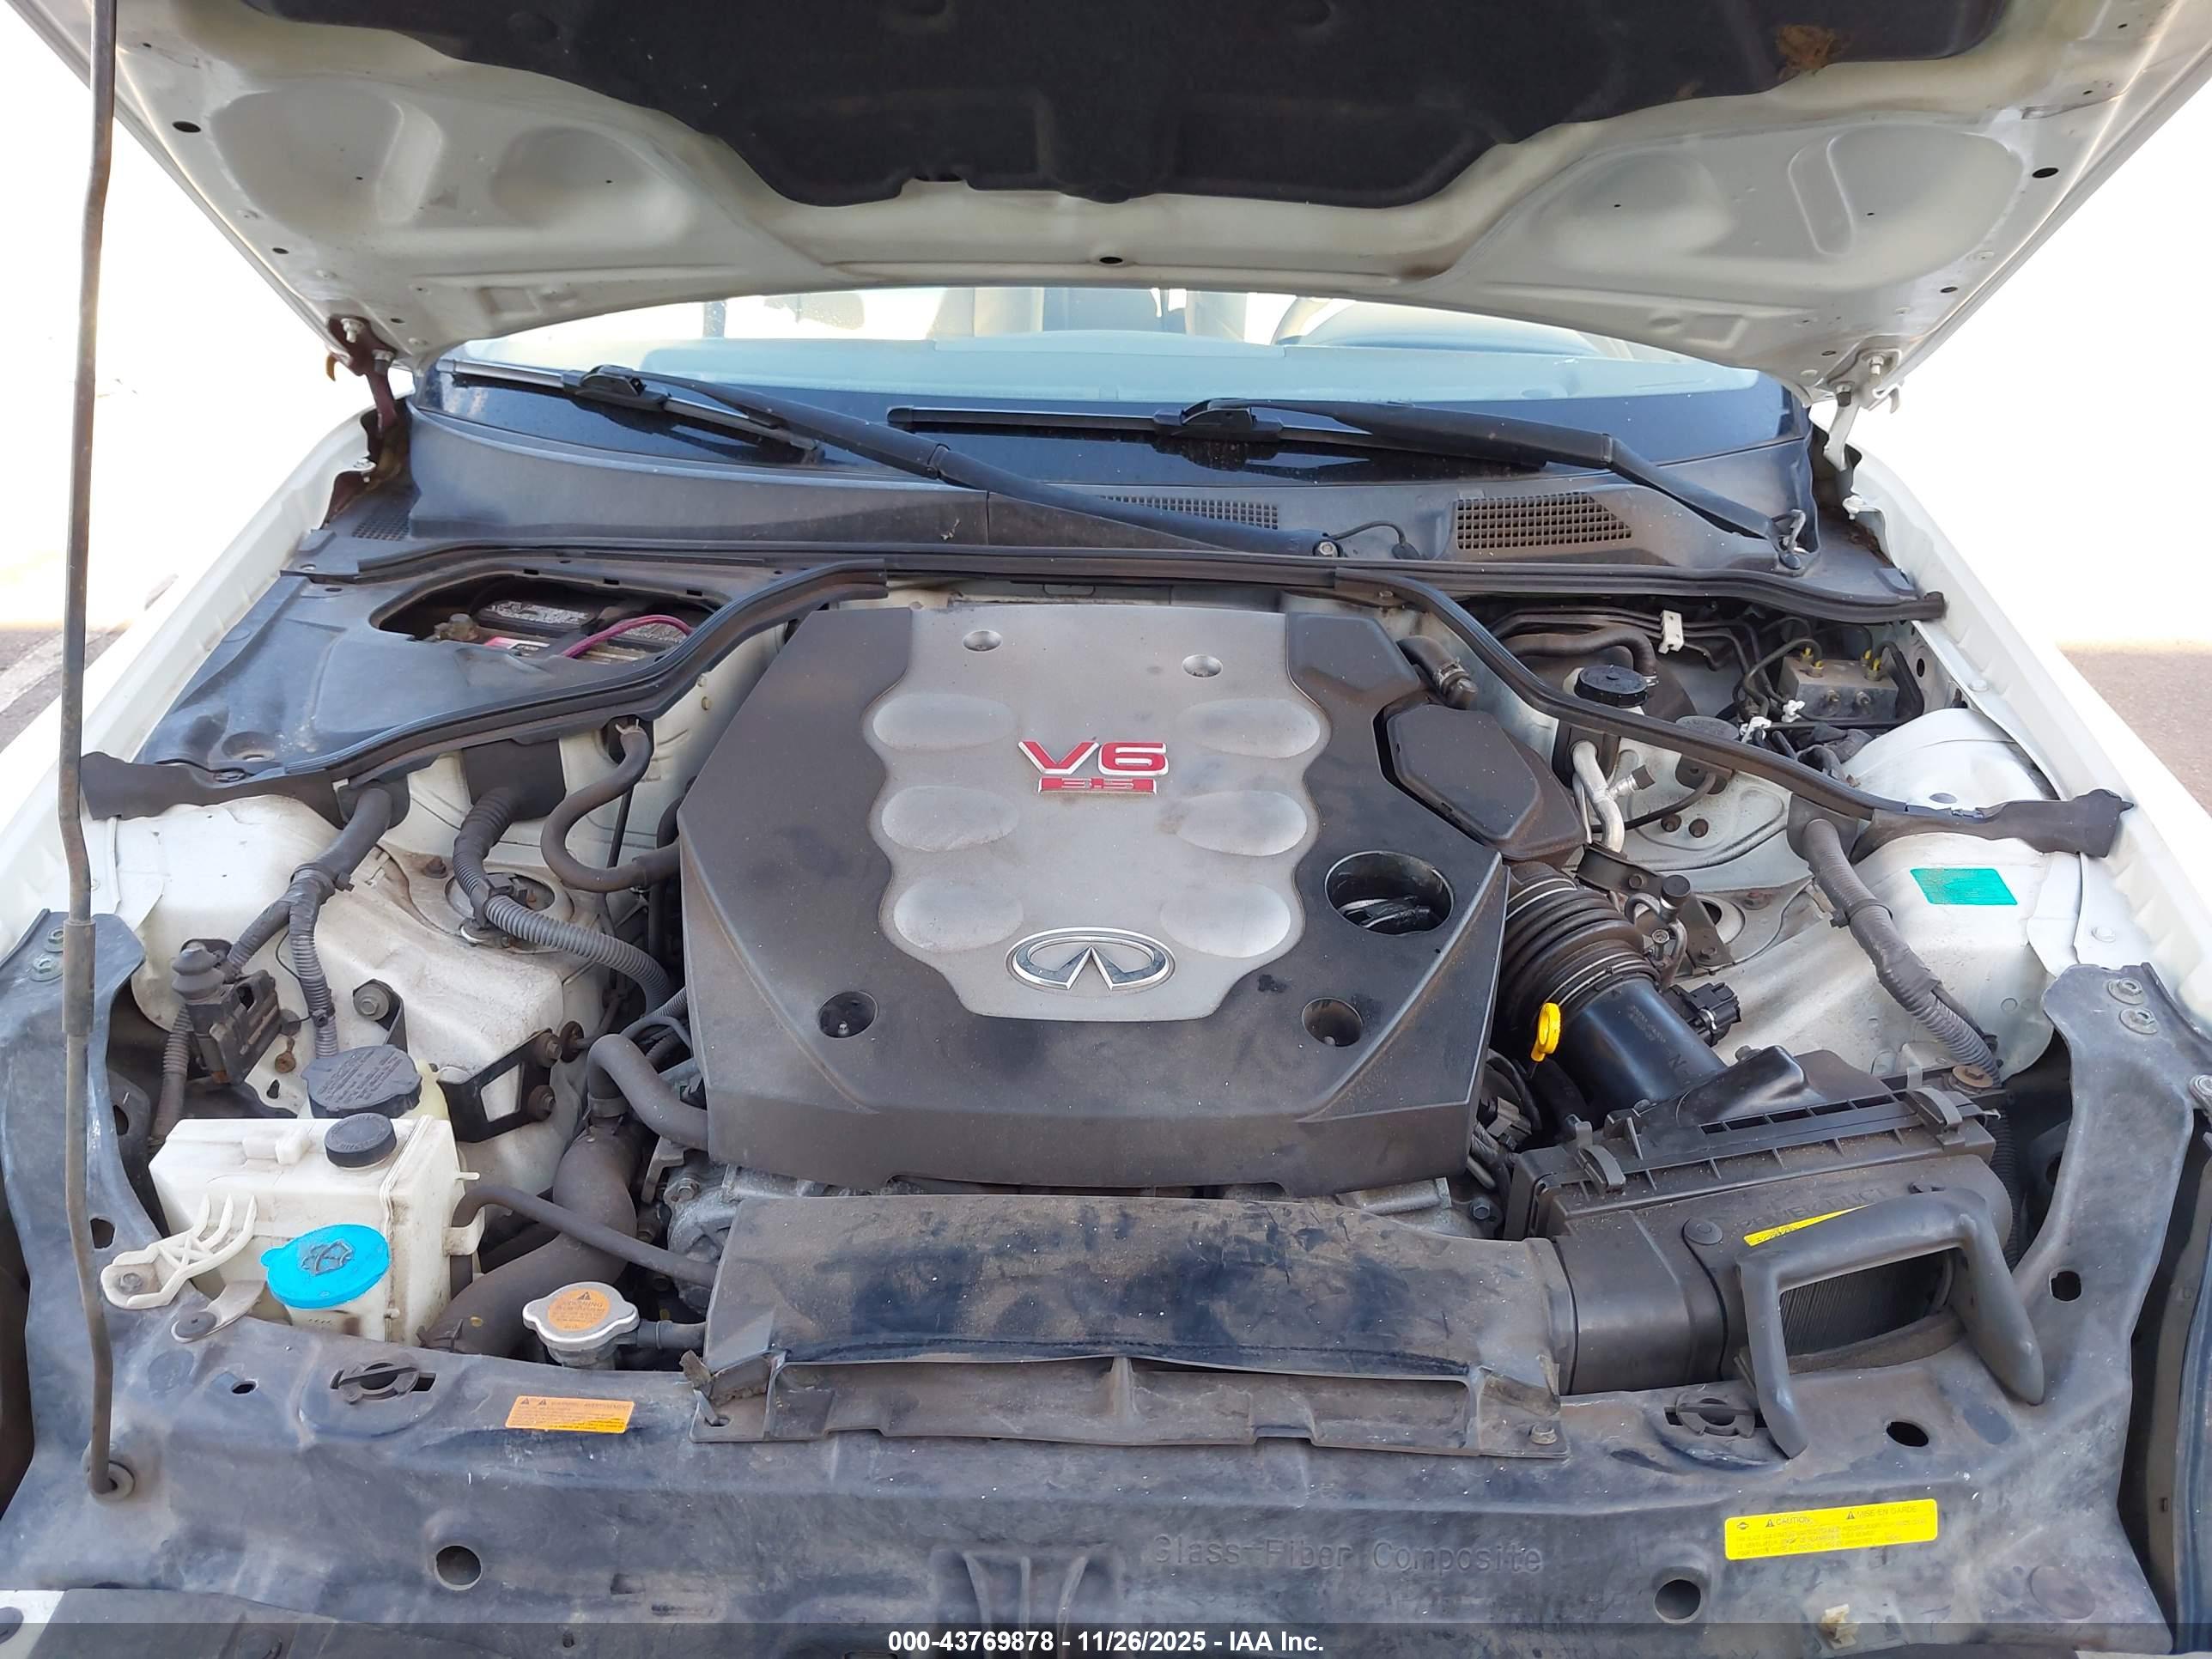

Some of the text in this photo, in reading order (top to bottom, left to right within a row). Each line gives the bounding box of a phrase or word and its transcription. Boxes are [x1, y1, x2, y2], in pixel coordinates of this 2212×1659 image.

[1018, 740, 1170, 775] V6
[1775, 1516, 1812, 1526] CAUTION
[1879, 1507, 1889, 1516] EN
[1890, 1506, 1917, 1516] GARDE
[1373, 1540, 1544, 1577] Composite
